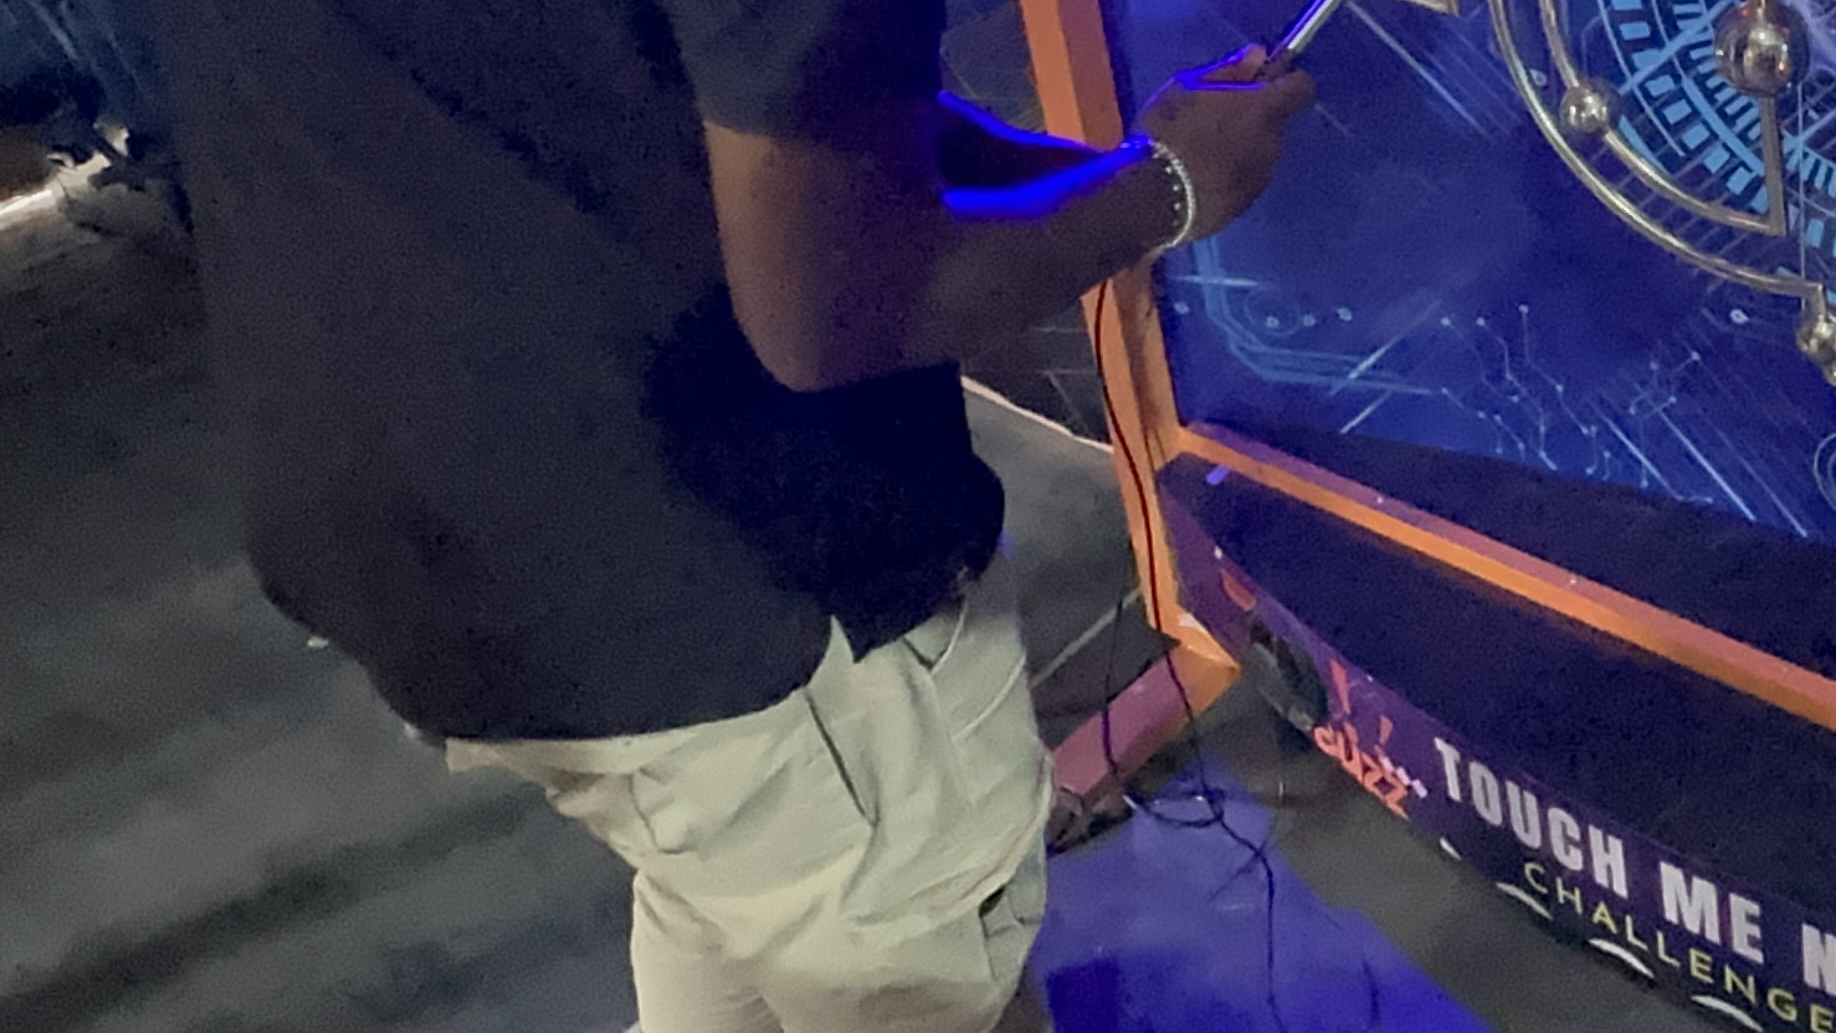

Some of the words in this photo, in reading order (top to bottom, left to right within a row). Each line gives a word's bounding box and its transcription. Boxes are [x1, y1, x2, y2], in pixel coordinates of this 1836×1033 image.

[1433, 736, 1629, 901] TOUCH
[1658, 860, 1765, 965] ME
[1523, 861, 1835, 1033] CHALLENGE
